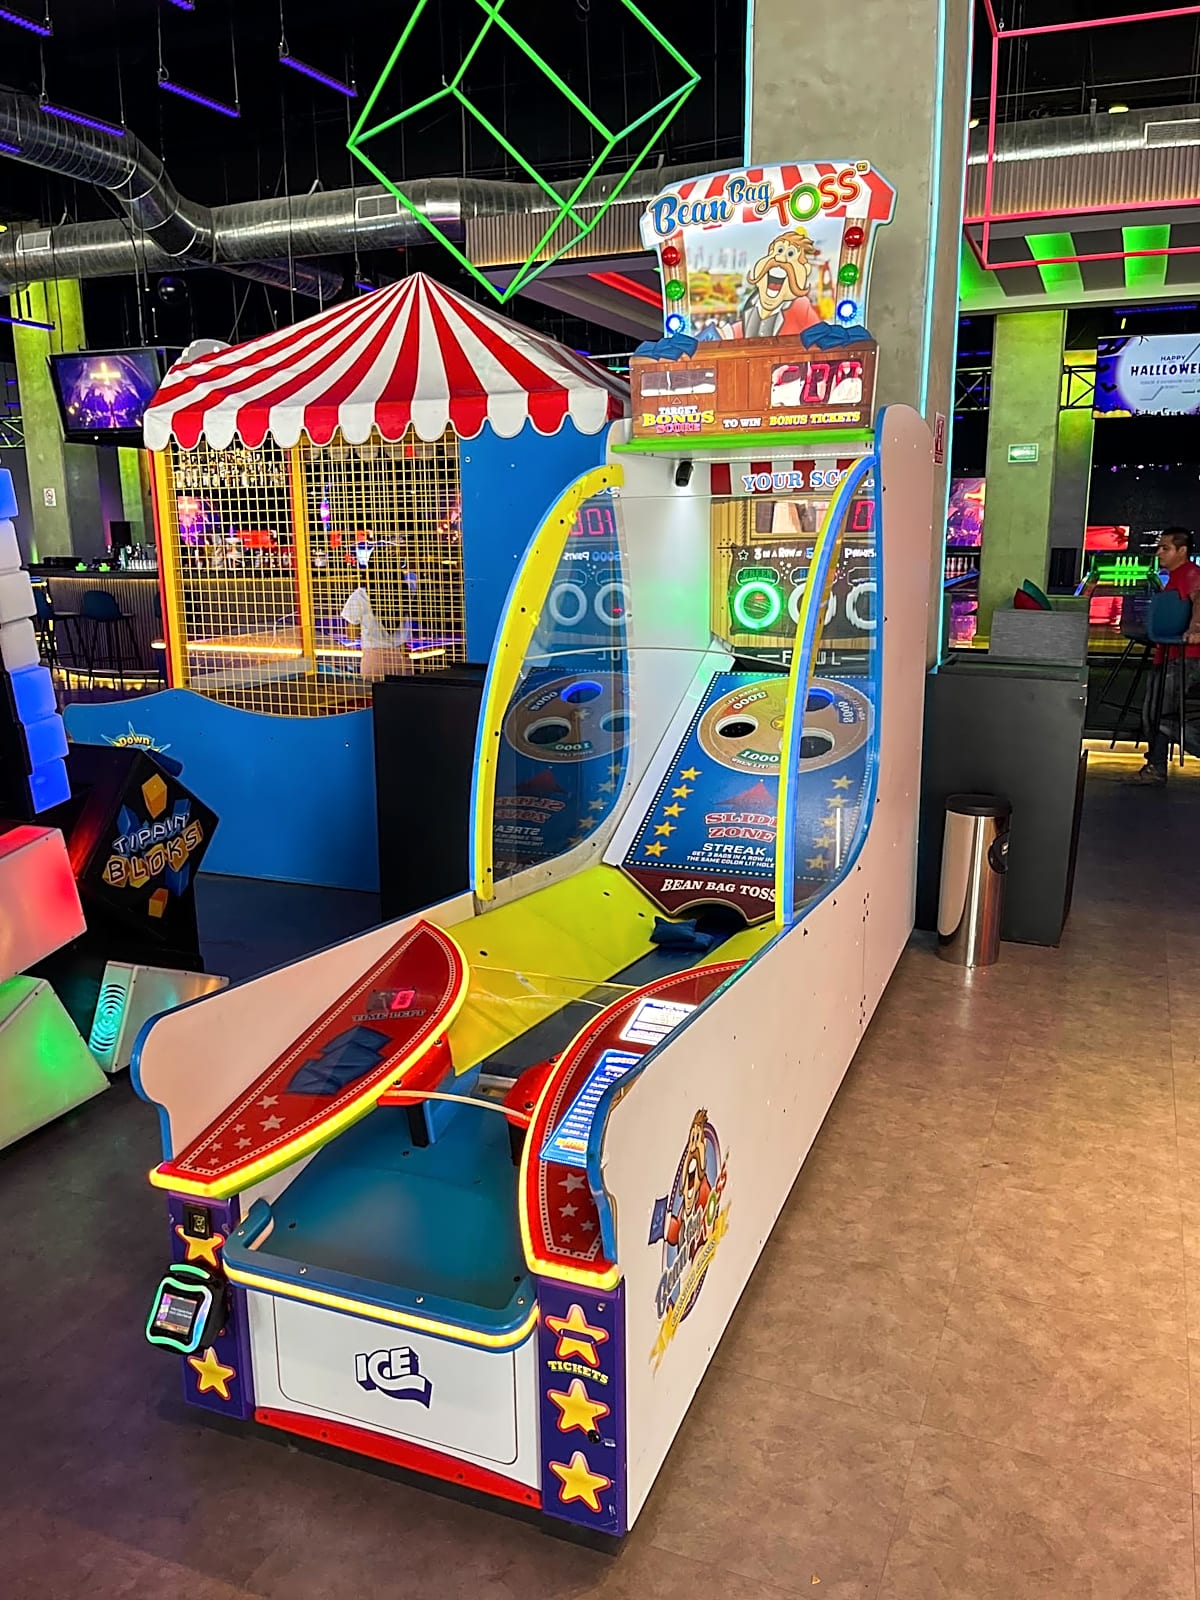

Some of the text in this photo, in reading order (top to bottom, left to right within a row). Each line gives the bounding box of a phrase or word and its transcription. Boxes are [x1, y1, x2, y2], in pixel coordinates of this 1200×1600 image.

[650, 196, 732, 236] Bean
[727, 177, 773, 214] Bag
[770, 169, 860, 226] TOSS
[1131, 363, 1200, 376] HALLLOWE
[642, 410, 715, 427] BONUS
[658, 405, 698, 415] TARGET
[723, 411, 861, 429] TO WIN BONUS TICKETS
[742, 471, 803, 492] YOUR
[740, 752, 779, 763] 1000
[708, 827, 777, 843] ZONE
[107, 827, 201, 885] BLOKS
[702, 843, 767, 856] STREAK
[661, 878, 776, 903] BEAN BAG TOSS
[355, 1346, 433, 1409] ICE
[547, 1360, 609, 1385] TICKETS
